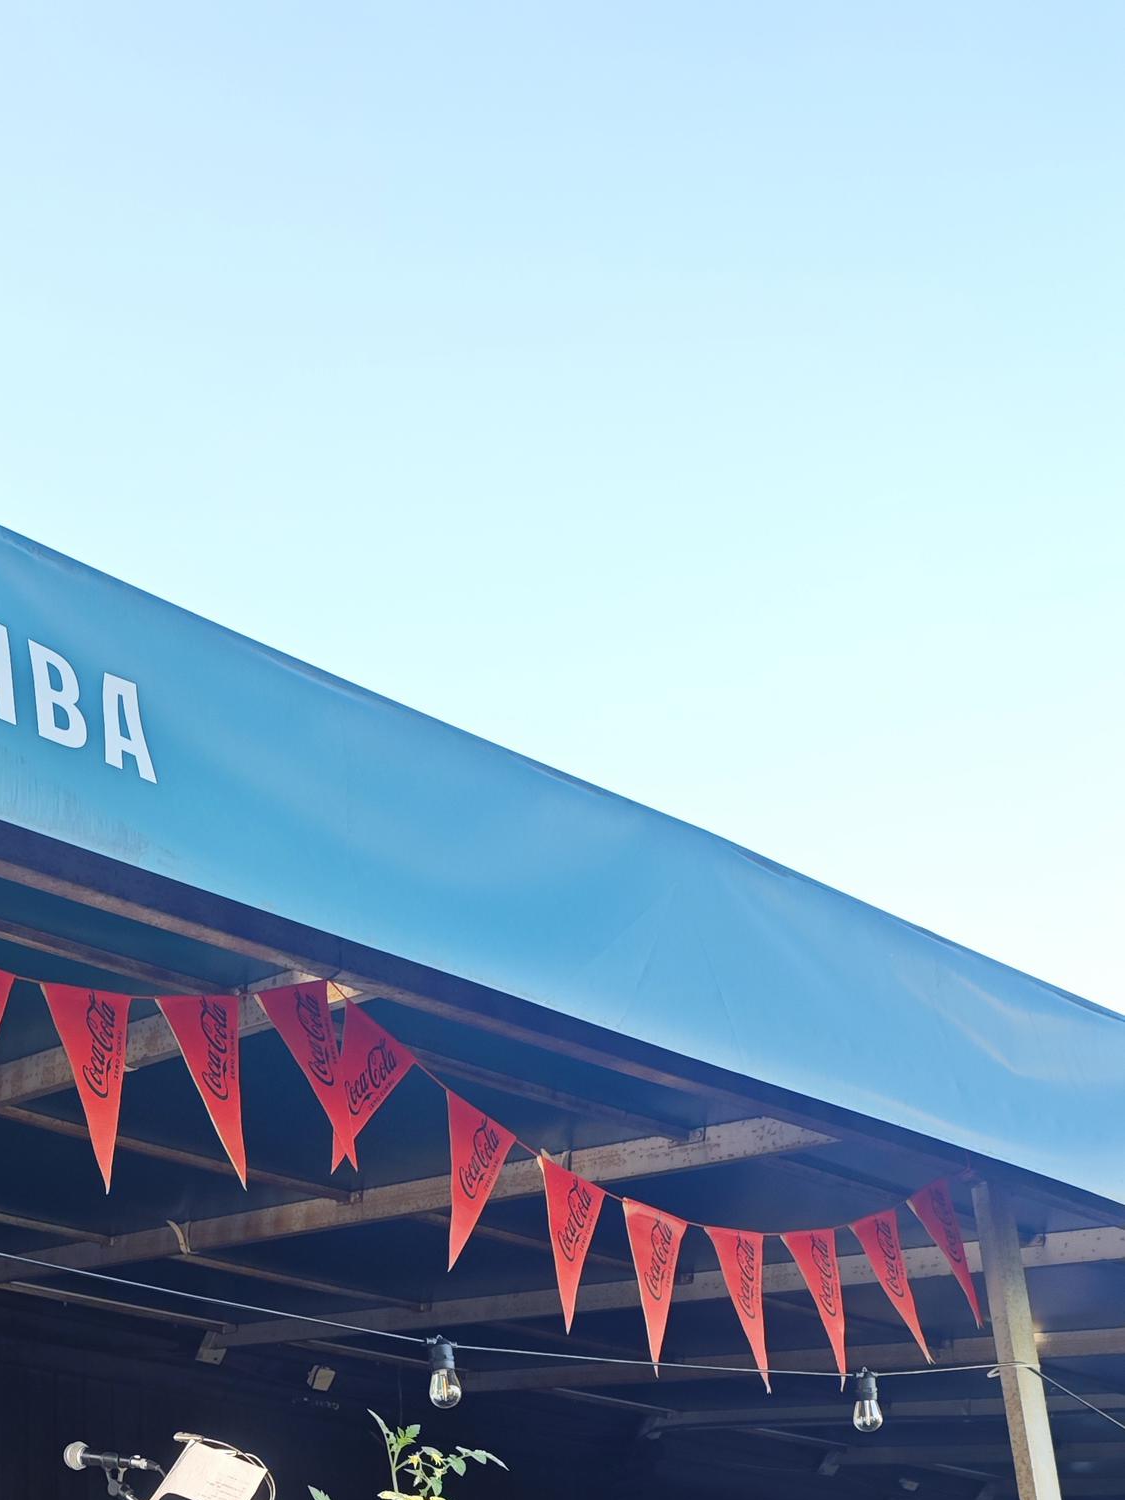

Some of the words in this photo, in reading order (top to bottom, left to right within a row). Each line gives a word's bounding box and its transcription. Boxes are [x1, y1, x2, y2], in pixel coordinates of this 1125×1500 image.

[82, 991, 116, 1098] Coca-Cola
[200, 996, 229, 1100] Coca-Cola
[459, 1116, 499, 1199] Coca-Cola
[558, 1175, 592, 1261] Coca-Cola
[644, 1213, 672, 1300] Coca-Cola
